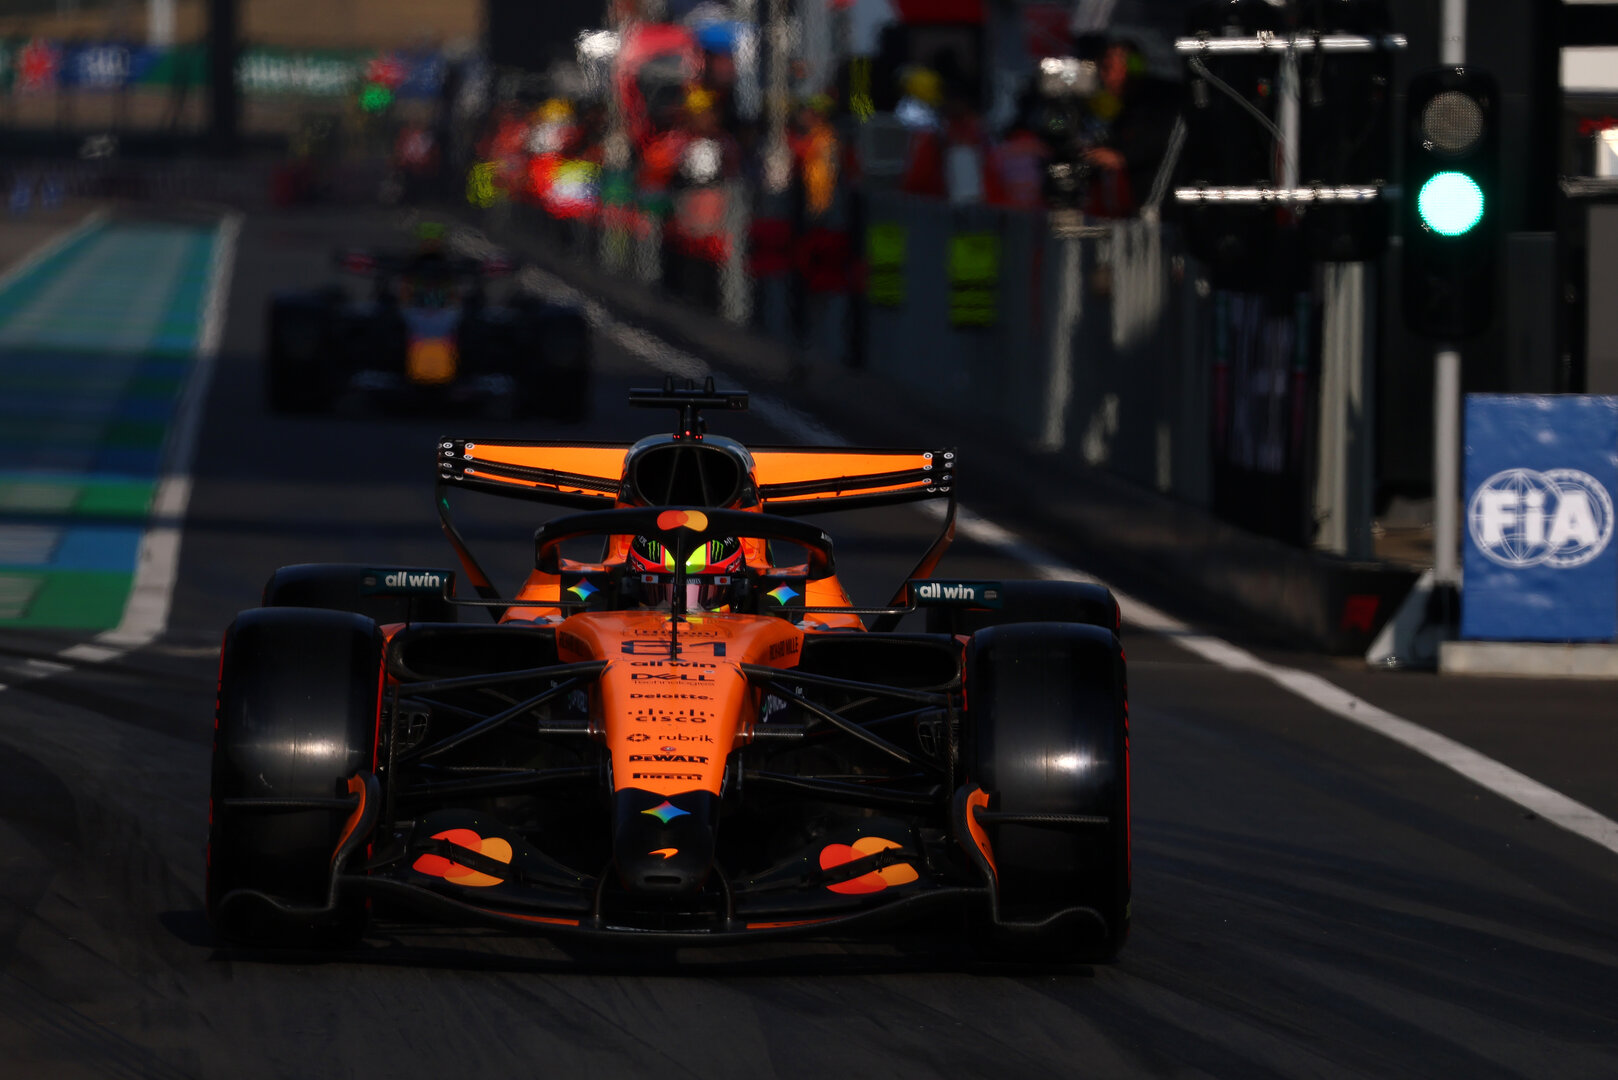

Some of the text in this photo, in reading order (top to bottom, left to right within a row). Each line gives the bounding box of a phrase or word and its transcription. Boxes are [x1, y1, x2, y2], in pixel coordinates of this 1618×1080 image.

[385, 571, 440, 588] all win
[919, 581, 975, 600] all win
[631, 673, 715, 681] DELL
[658, 733, 714, 743] rubrik
